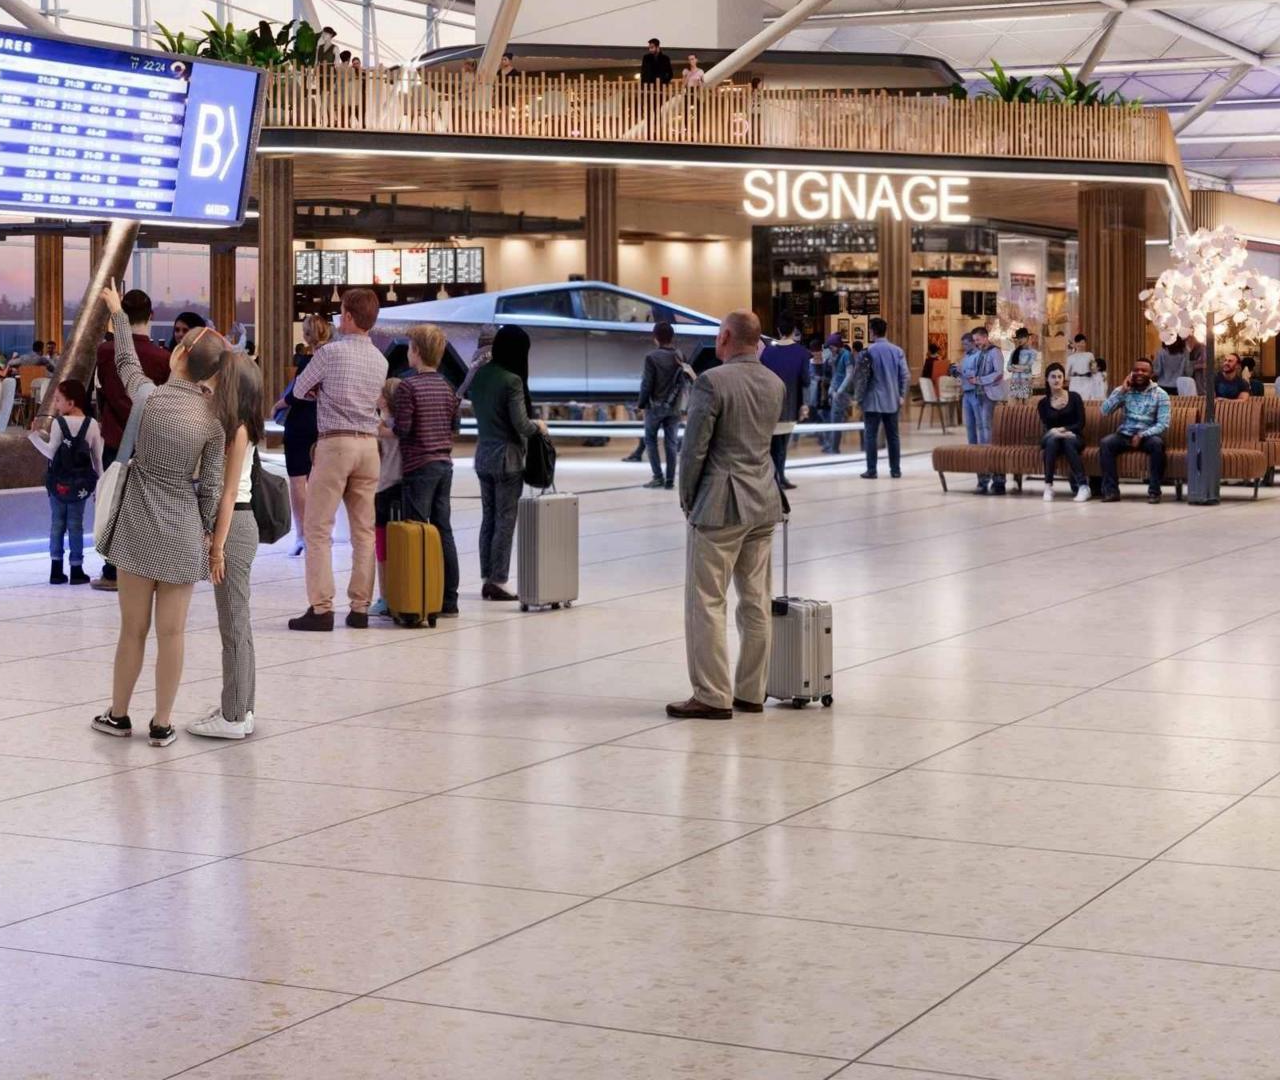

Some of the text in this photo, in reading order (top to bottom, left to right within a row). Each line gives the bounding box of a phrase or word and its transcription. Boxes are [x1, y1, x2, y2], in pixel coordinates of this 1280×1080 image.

[143, 60, 166, 72] 22:24
[140, 111, 173, 123] DELAYED
[143, 134, 164, 144] OPEN
[190, 103, 223, 178] B
[140, 156, 161, 165] OPEN
[138, 178, 159, 187] OPEN
[742, 169, 971, 222] SIGNAGE
[136, 201, 156, 210] OPEN
